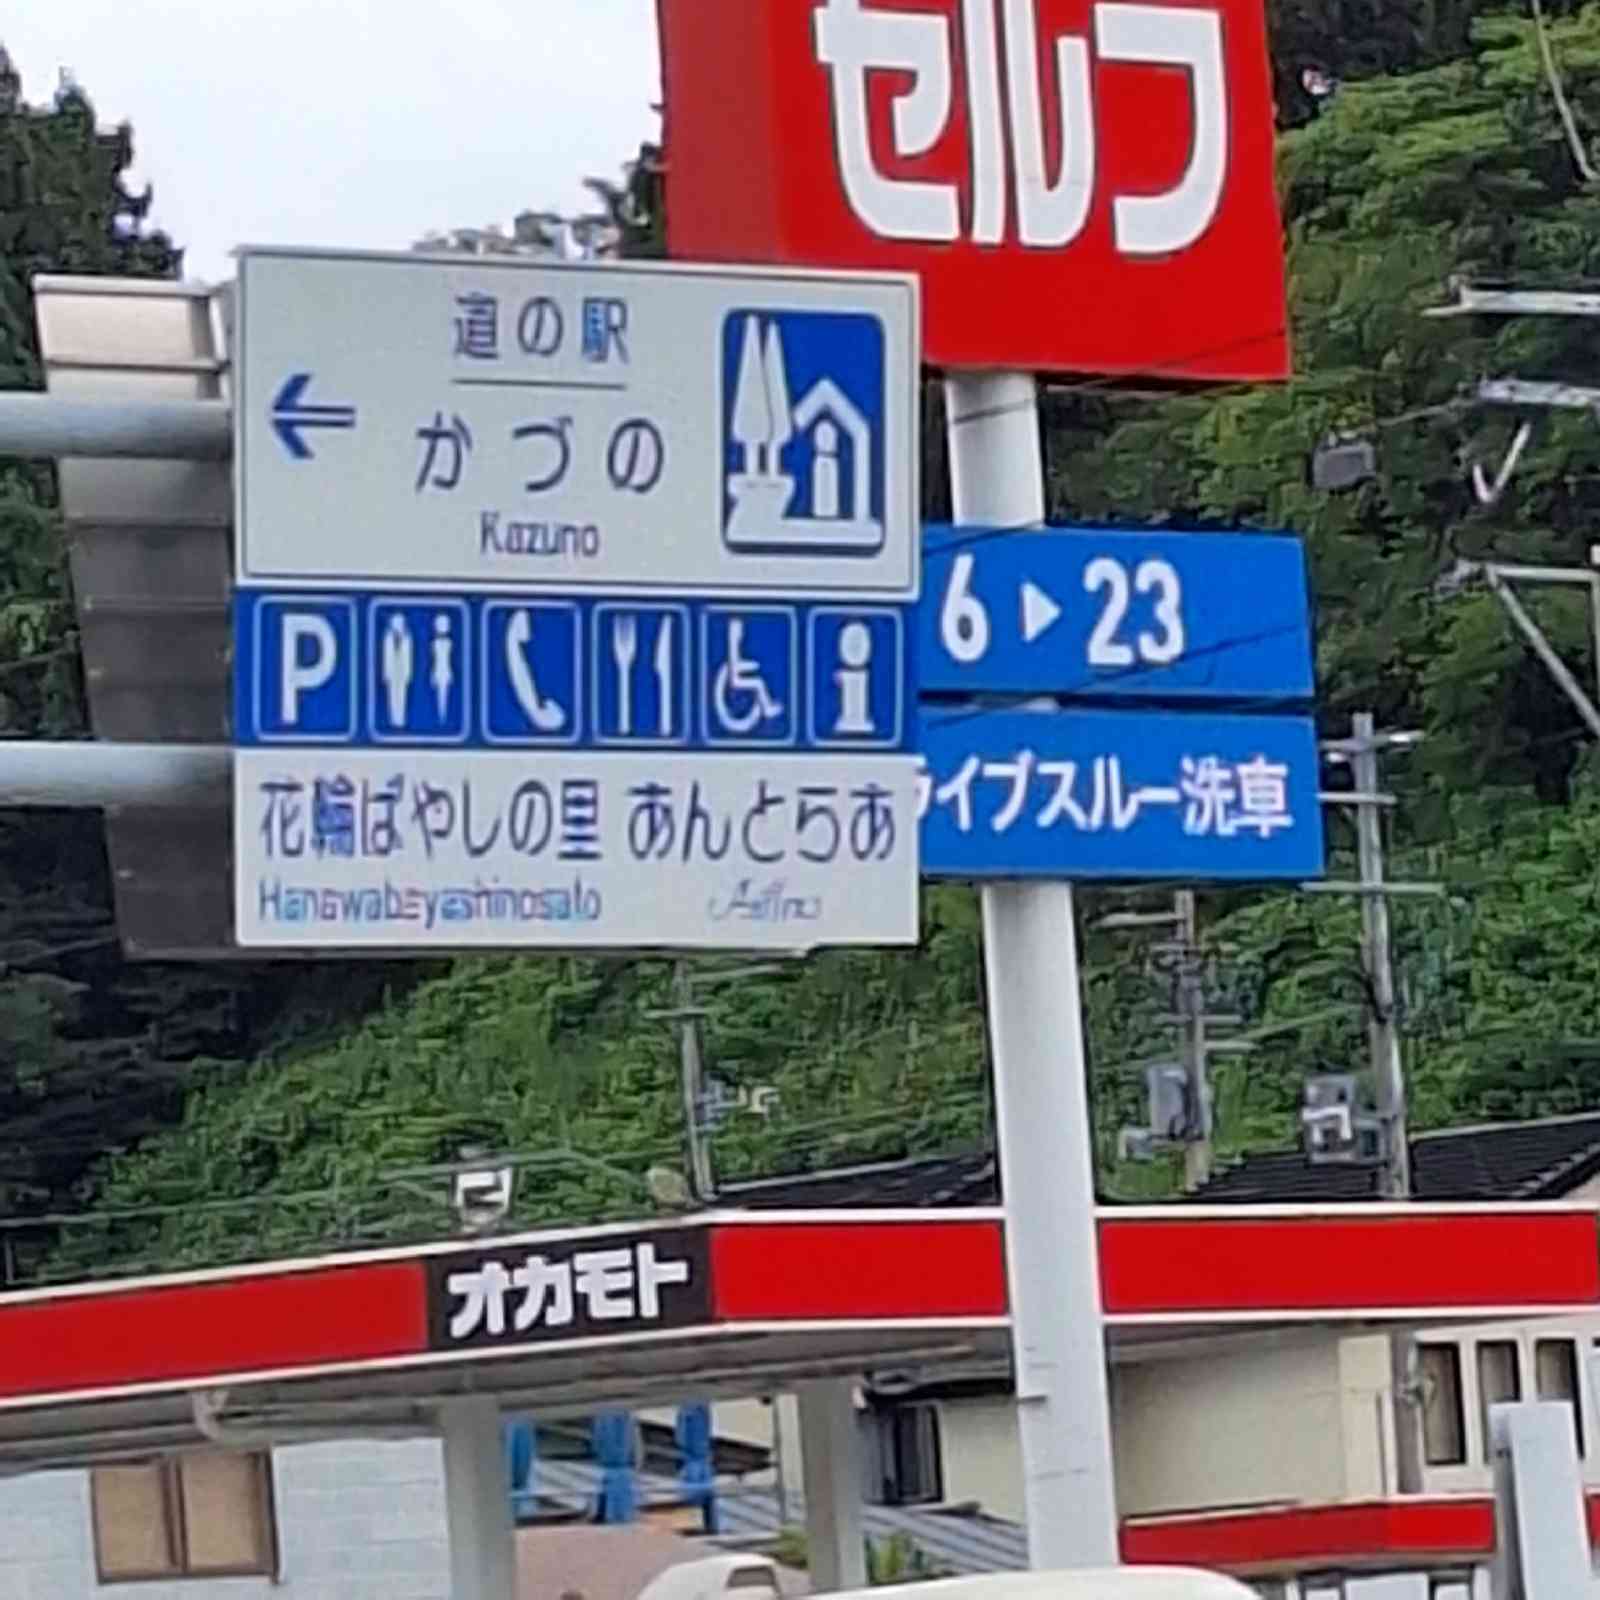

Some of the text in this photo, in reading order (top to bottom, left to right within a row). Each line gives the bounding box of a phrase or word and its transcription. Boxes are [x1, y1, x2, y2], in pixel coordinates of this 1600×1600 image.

[815, 0, 1228, 254] セルフ
[453, 292, 629, 364] 道の駅
[415, 410, 665, 493] かづの
[480, 509, 601, 558] Kazuno
[941, 553, 1186, 665] 6 23
[259, 772, 896, 863] 花輪ばやしの里 あんとらあ
[447, 1242, 689, 1339] オカモト
